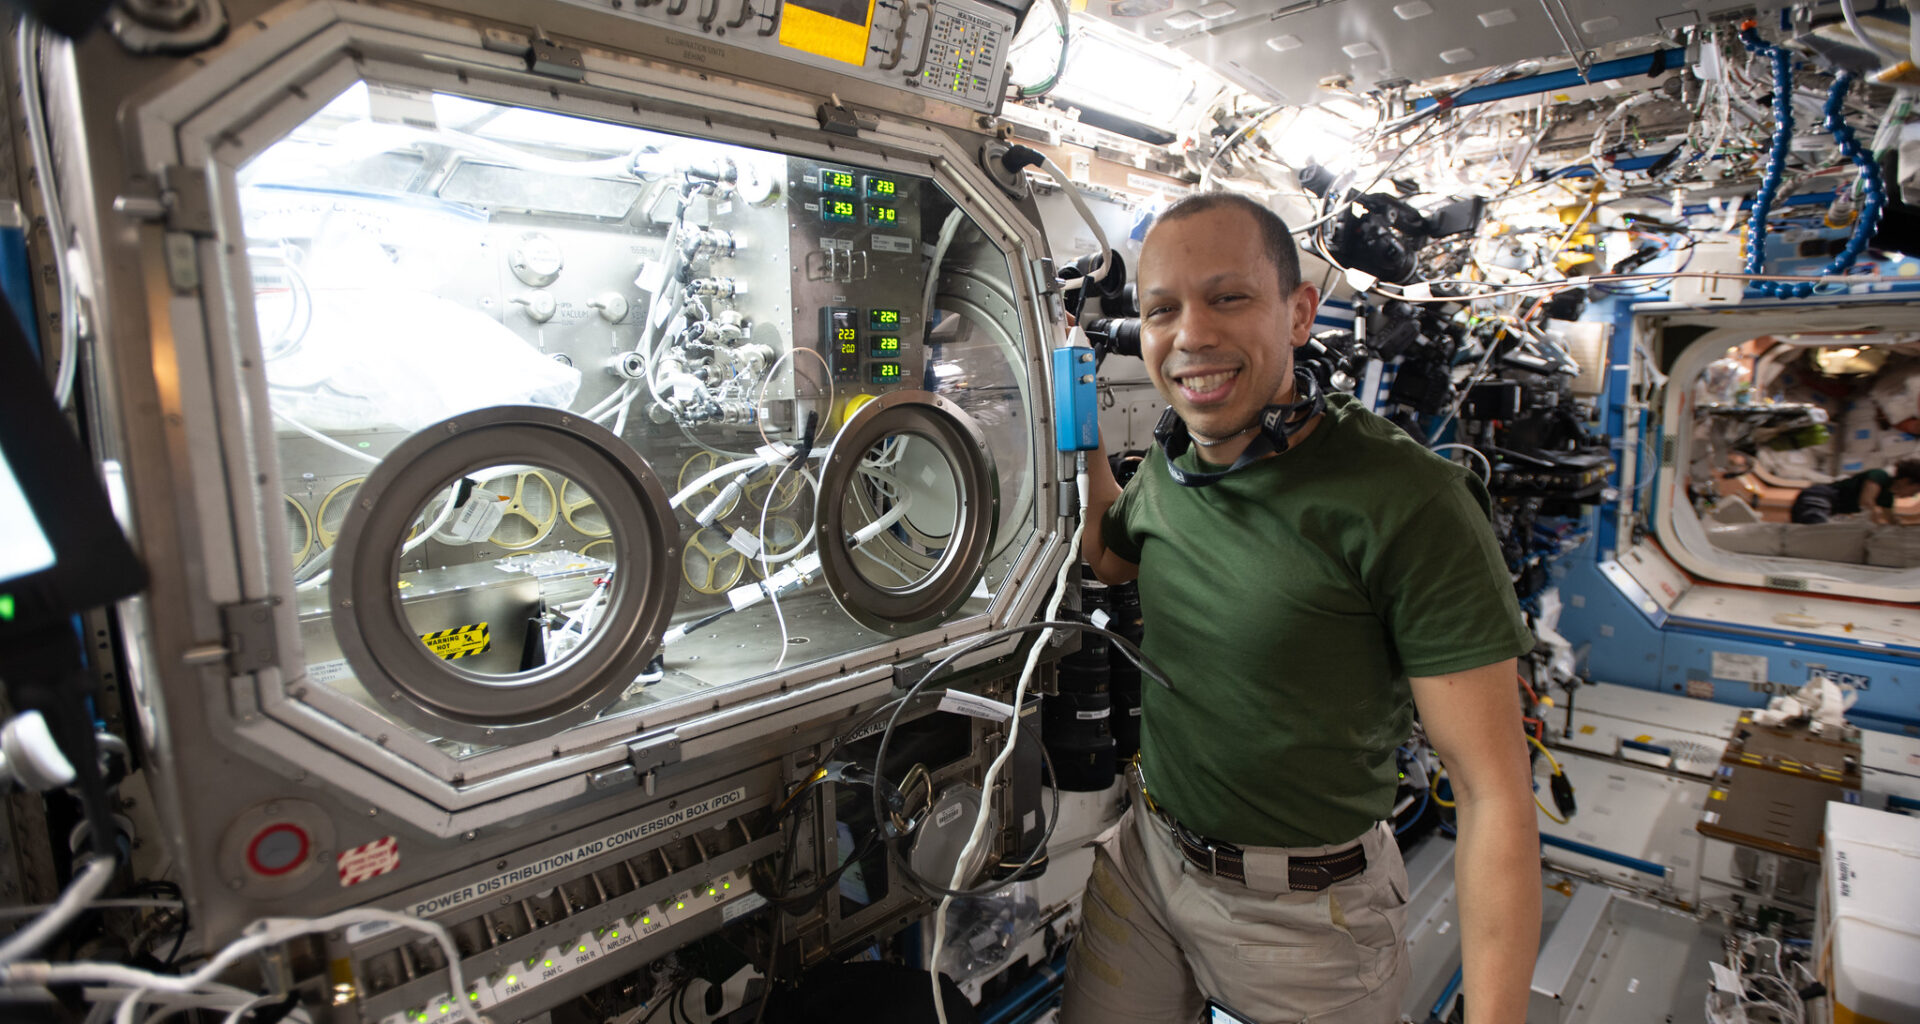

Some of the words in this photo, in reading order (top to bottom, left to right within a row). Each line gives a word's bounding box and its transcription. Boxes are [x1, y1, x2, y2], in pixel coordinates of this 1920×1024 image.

[957, 11, 972, 21] HEALTH
[977, 18, 991, 29] STATUS
[561, 310, 589, 320] VACUUM
[427, 635, 460, 647] WARNING
[416, 888, 473, 916] POWER
[477, 851, 573, 895] DISTRIBUTION
[576, 841, 603, 859] AND
[607, 812, 684, 848] CONVERSION
[686, 801, 710, 819] BOX
[711, 790, 741, 810] (PDC)
[607, 934, 632, 951] AIRLOCK
[576, 953, 590, 964] FAN
[542, 968, 557, 980] FAN
[505, 985, 521, 996] FAN
